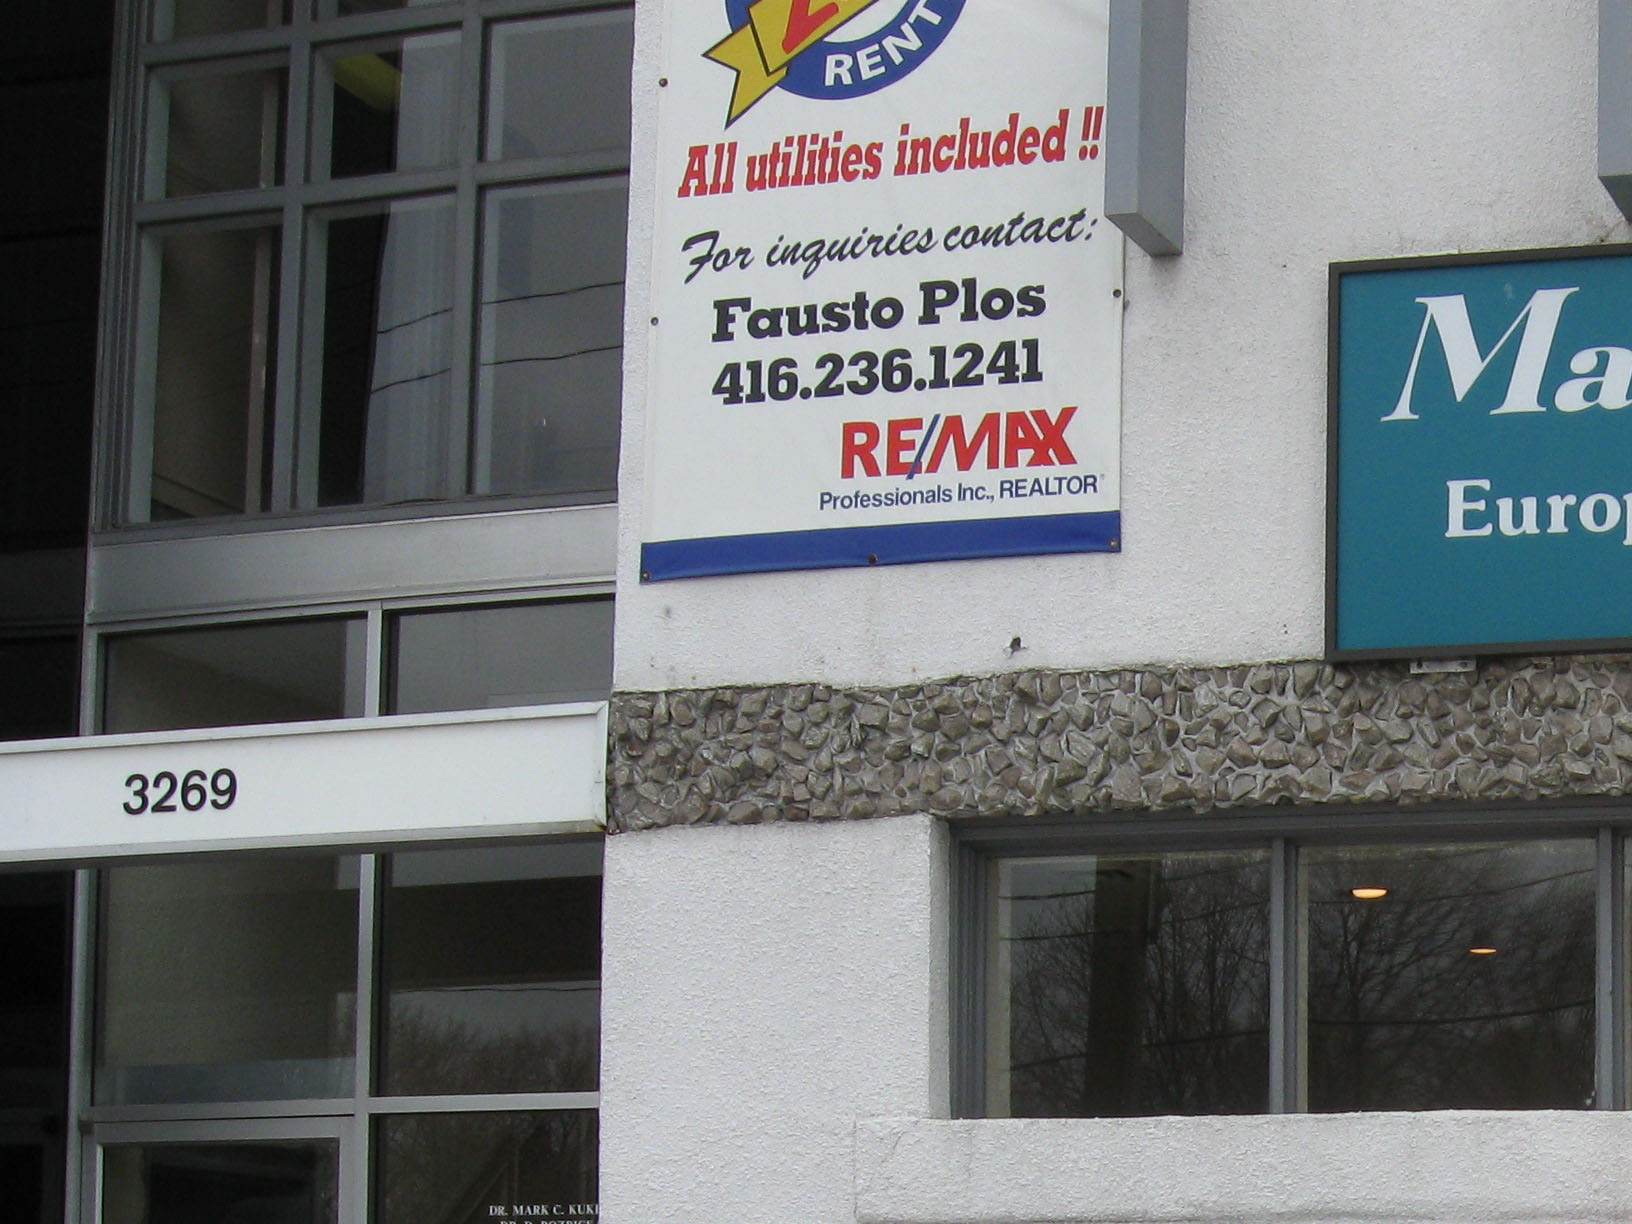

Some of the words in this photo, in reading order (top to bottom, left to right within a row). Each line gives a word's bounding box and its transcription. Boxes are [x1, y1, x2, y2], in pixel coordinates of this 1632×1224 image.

[824, 5, 944, 87] RENT
[677, 142, 738, 198] All
[745, 130, 883, 193] utilities
[894, 109, 1069, 176] included
[681, 230, 754, 284] For
[766, 219, 937, 279] inquiries
[943, 208, 1097, 248] contact:
[711, 290, 904, 343] Fausto
[918, 277, 1046, 325] Plos
[712, 338, 1043, 405] 416.236.1241
[840, 406, 1078, 479] RE/MAX
[819, 485, 953, 511] Professionals
[957, 482, 995, 503] Inc.,
[1000, 474, 1098, 499] REALTOR
[122, 768, 238, 815] 3269
[488, 1204, 508, 1216] DR.
[512, 1204, 549, 1216] MARK
[553, 1204, 564, 1216] C.
